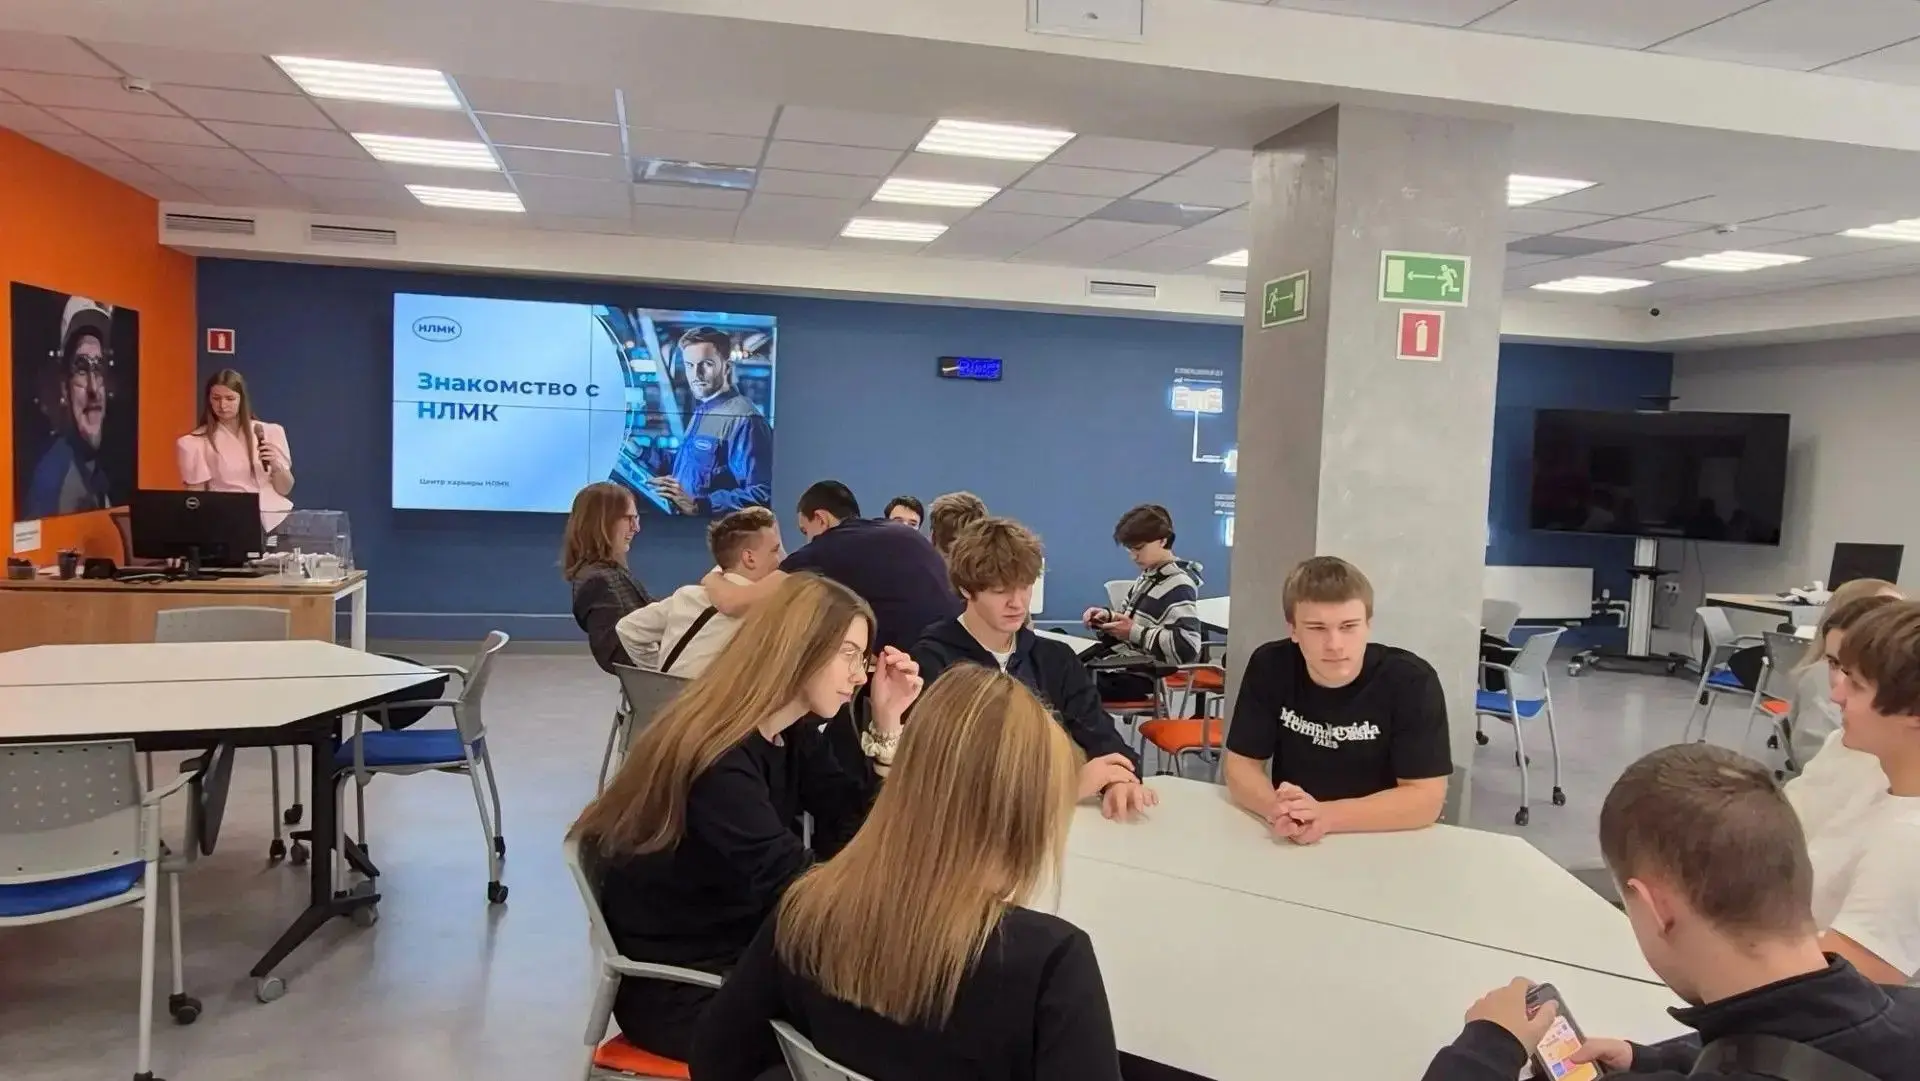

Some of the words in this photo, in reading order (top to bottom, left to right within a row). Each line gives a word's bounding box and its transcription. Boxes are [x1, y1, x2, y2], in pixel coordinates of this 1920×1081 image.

[418, 324, 456, 334] НЛМК
[418, 372, 578, 396] Знакомство
[585, 383, 600, 397] с
[418, 401, 499, 422] НЛМК
